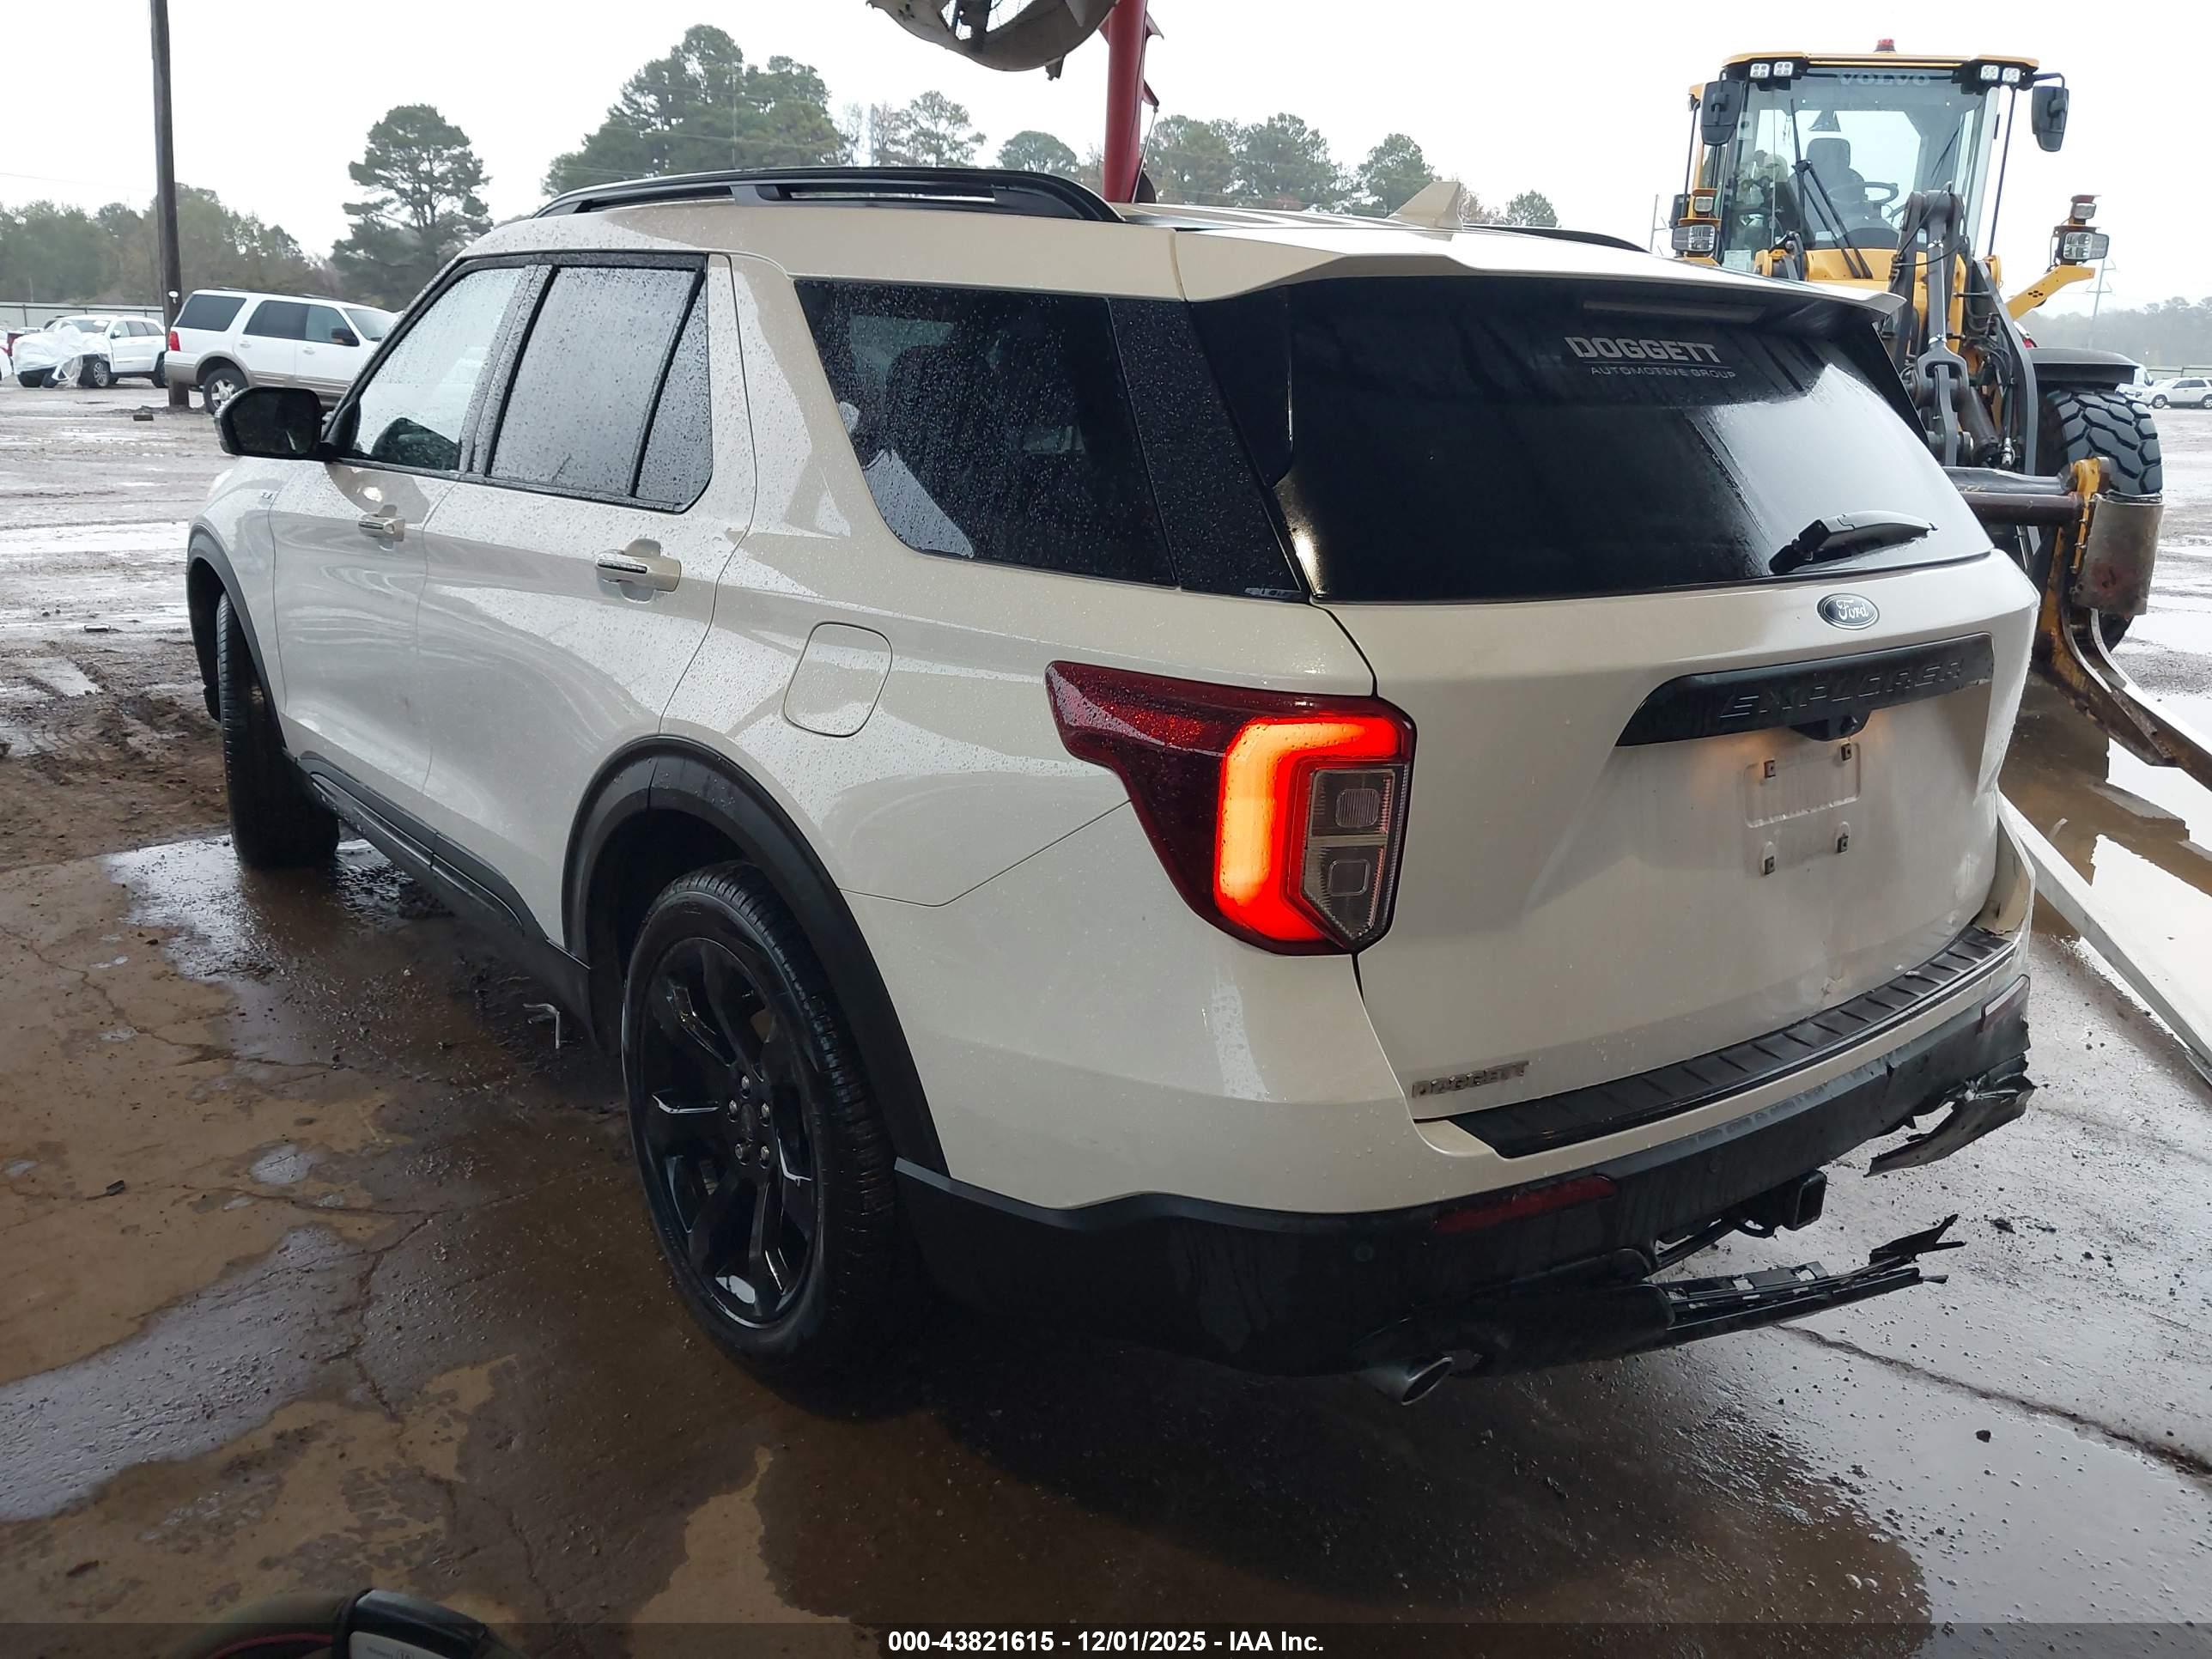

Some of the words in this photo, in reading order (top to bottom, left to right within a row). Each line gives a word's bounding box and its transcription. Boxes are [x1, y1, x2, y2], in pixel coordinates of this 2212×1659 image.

[1564, 337, 1722, 363] DOGGETT
[1590, 366, 1689, 377] AUTOMOTIVE
[1690, 368, 1736, 379] GROUP
[1835, 599, 1869, 621] Ford
[1717, 659, 1966, 719] EXPLORER
